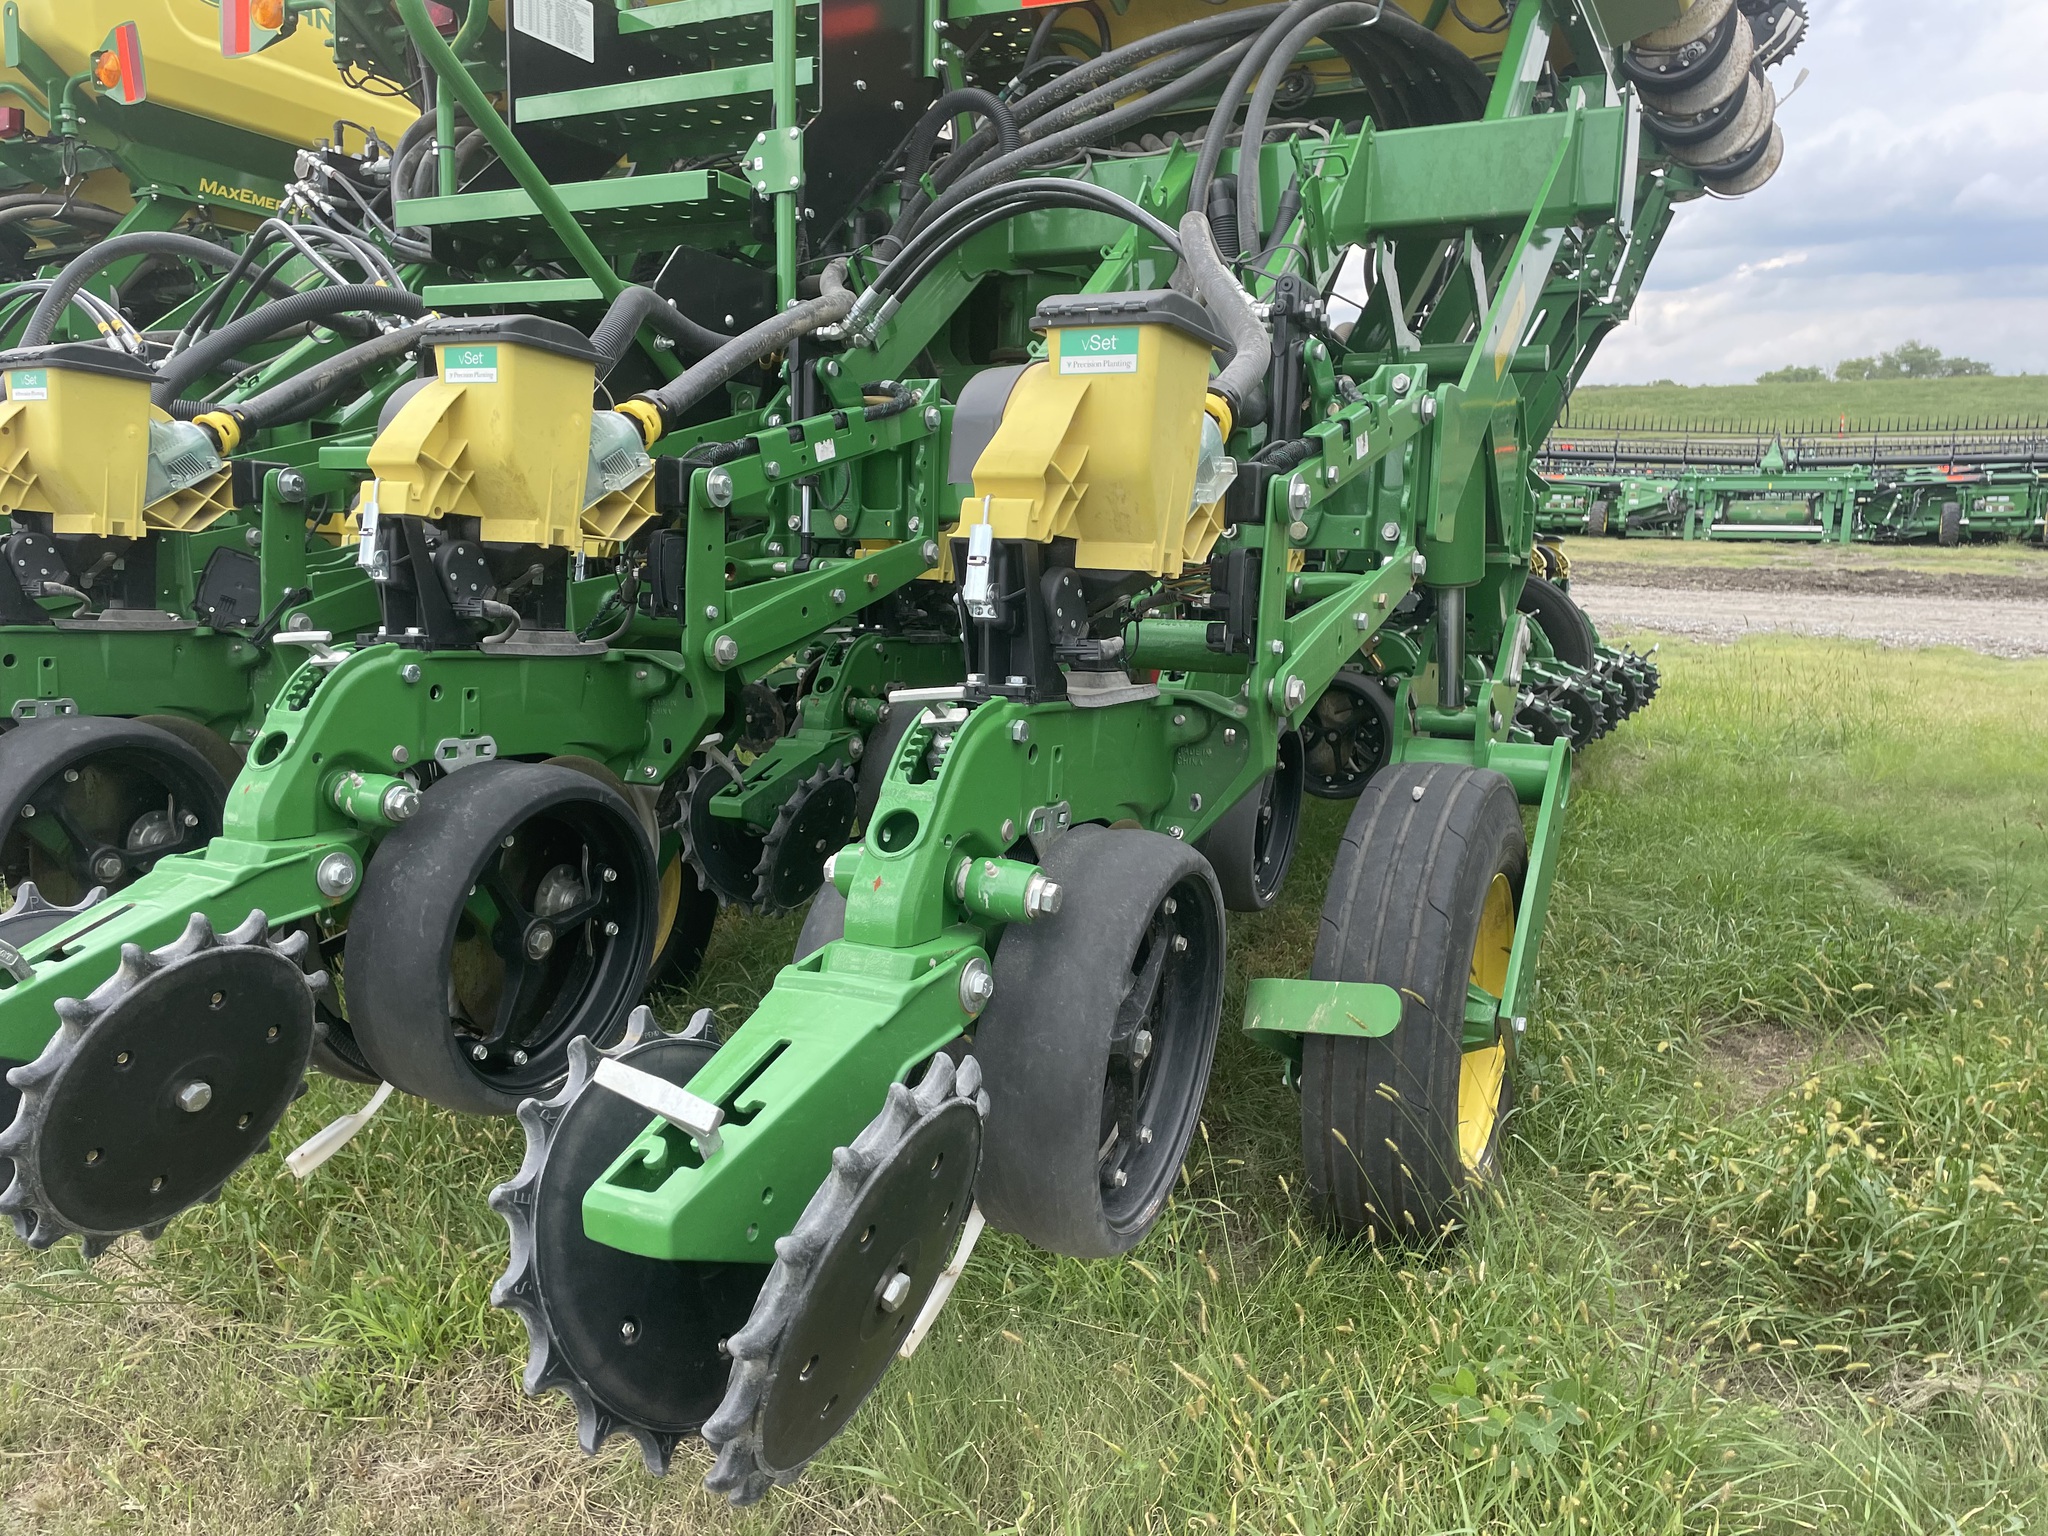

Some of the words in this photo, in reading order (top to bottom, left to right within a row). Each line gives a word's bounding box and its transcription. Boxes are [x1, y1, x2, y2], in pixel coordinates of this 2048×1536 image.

[1081, 334, 1117, 352] vSet
[458, 350, 484, 365] vSet
[1073, 360, 1102, 369] Precision
[1103, 359, 1131, 369] Planting
